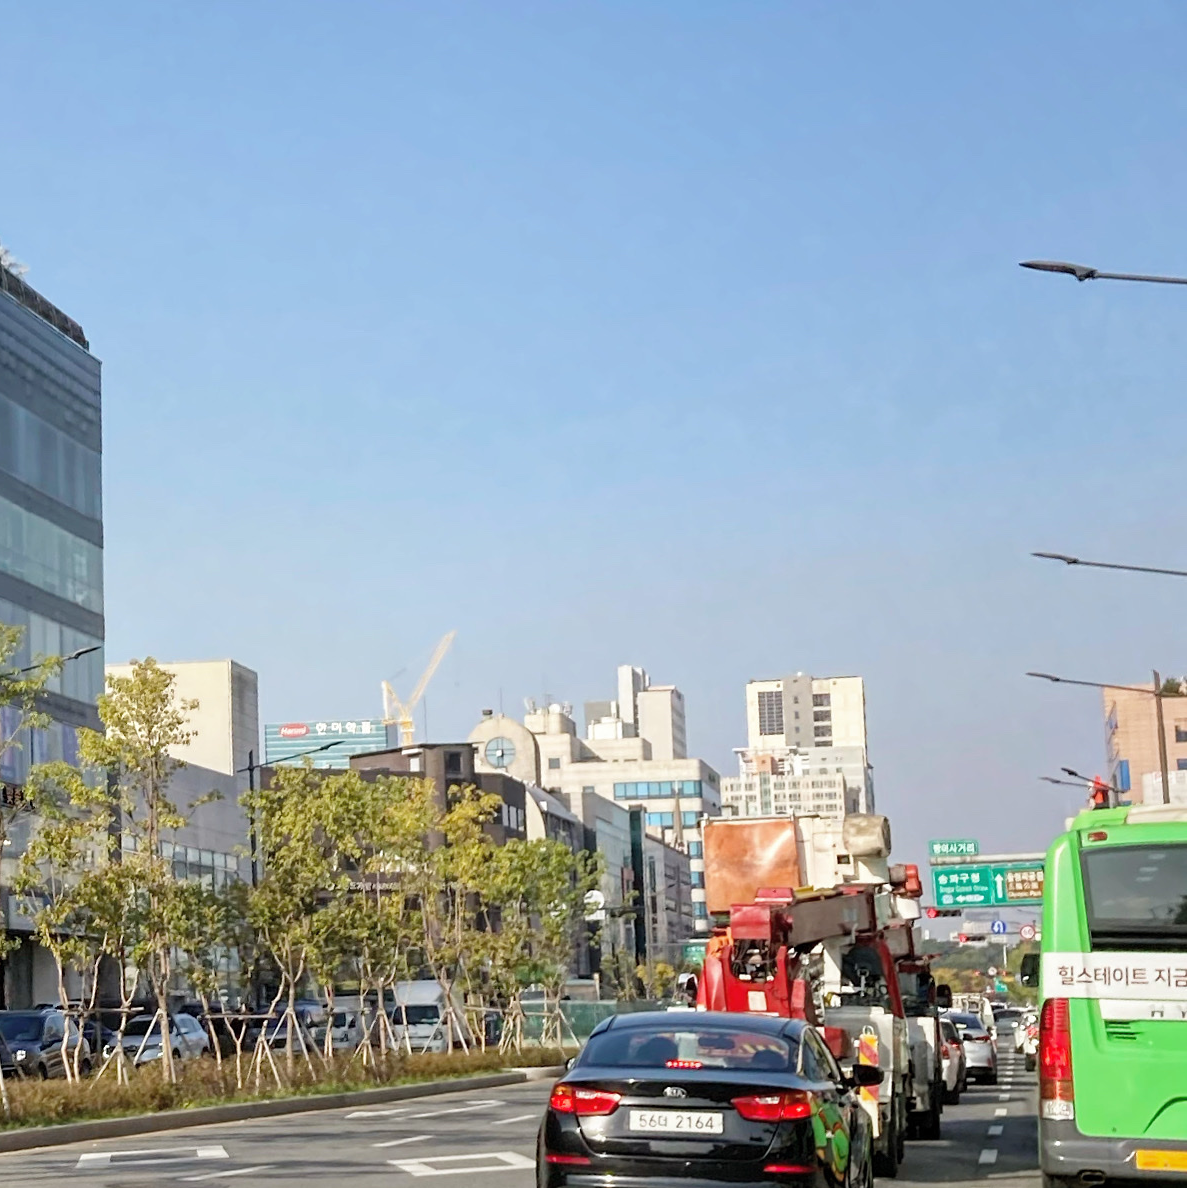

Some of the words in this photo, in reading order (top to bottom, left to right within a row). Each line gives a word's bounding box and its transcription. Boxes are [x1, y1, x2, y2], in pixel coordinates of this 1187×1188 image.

[315, 721, 371, 735] 한미약품
[938, 872, 980, 885] 송파구청
[1058, 965, 1149, 986] 힐스테이트
[675, 1116, 714, 1129] 2164
